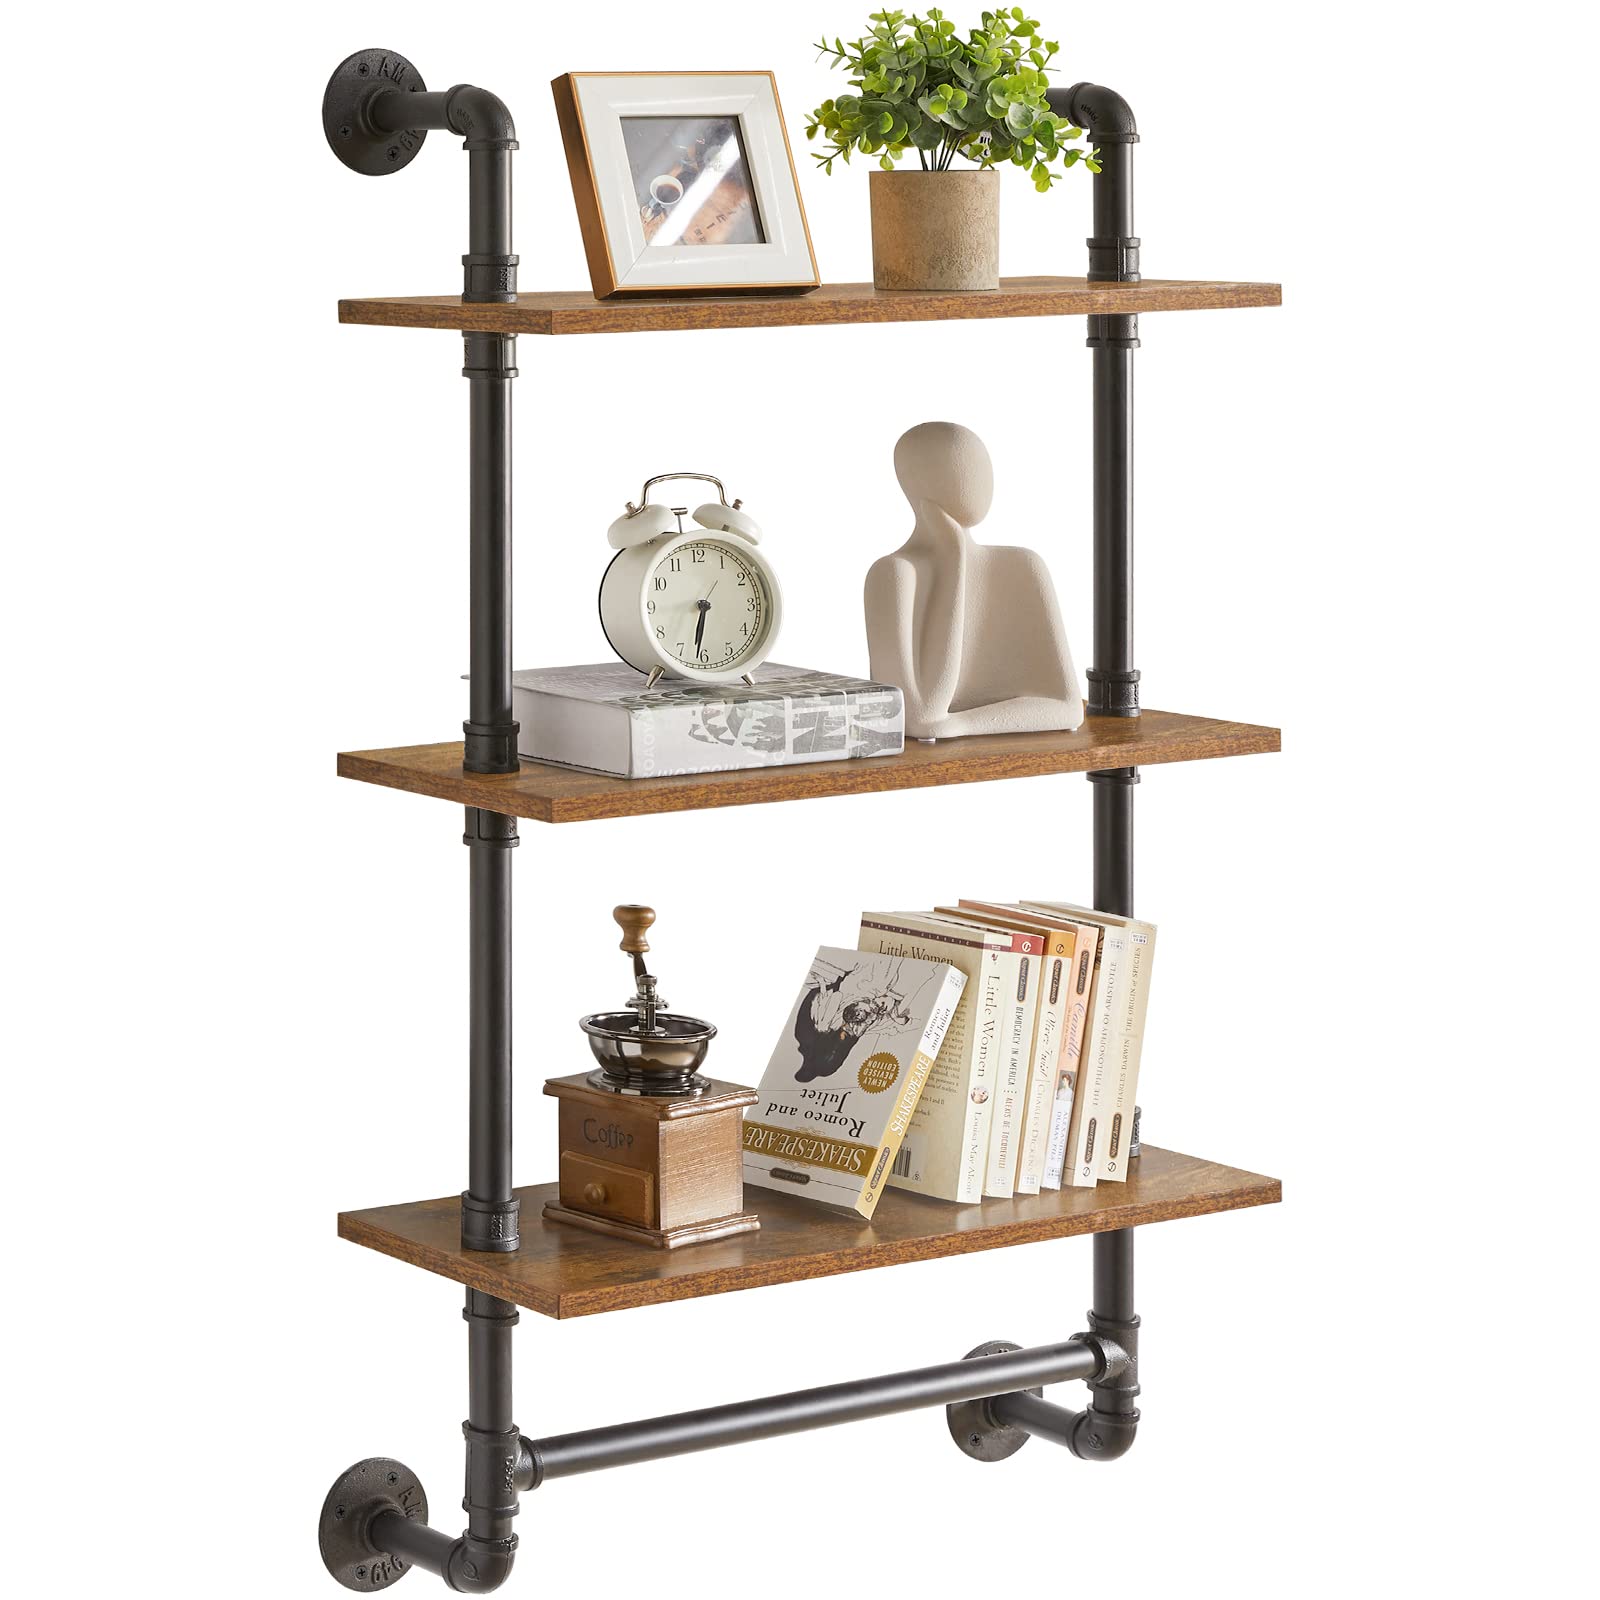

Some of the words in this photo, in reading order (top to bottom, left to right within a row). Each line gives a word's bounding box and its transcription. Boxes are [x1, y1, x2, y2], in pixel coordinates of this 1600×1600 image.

[670, 558, 681, 572] 11
[692, 549, 705, 563] 12
[719, 556, 725, 569] 1
[654, 577, 667, 591] 10
[736, 572, 746, 586] 2
[646, 600, 656, 615] 9
[746, 598, 755, 612] 3
[655, 625, 666, 639] 8
[739, 622, 749, 635] 4
[676, 643, 685, 656] 7
[699, 649, 709, 663] 6
[724, 642, 734, 656] 5
[879, 940, 908, 958] Little
[1133, 947, 1142, 977] SPECIES
[985, 975, 1000, 1015] Little
[1106, 962, 1117, 1010] ARISTOTLE
[1128, 988, 1137, 1015] ORIGIN
[924, 1008, 941, 1039] Romeo
[931, 1032, 941, 1051] and
[937, 1008, 951, 1033] Juliet
[1012, 1006, 1024, 1045] DEMOCRACY
[1043, 1011, 1057, 1045] Oliver
[1067, 1002, 1086, 1059] Camille
[1104, 1014, 1110, 1025] OF
[1125, 1017, 1133, 1032] THE
[978, 1020, 996, 1078] Women
[1039, 1046, 1053, 1078] Twist
[1095, 1027, 1108, 1086] PHILOSOPHY
[1121, 1039, 1130, 1073] DARWIN
[863, 1068, 895, 1080] REVISED
[867, 1060, 897, 1071] EDITION
[1008, 1058, 1018, 1086] AMERICA
[863, 1077, 888, 1088] NEWLY
[1116, 1073, 1127, 1108] CHARLES
[765, 1102, 798, 1116] and
[800, 1088, 852, 1114] Juliet
[890, 1057, 931, 1137] SHAKESPEARE
[1003, 1097, 1013, 1119] ALEXIS
[1032, 1084, 1046, 1126] CHARLES
[583, 1118, 634, 1150] Coffee
[804, 1110, 866, 1139] Romeo
[970, 1112, 982, 1142] Louisa
[1003, 1120, 1010, 1129] DE
[743, 1126, 866, 1172] SHAKESPEARE
[969, 1144, 979, 1164] May
[1026, 1129, 1041, 1173] DICKENS
[966, 1168, 976, 1195] Alcott
